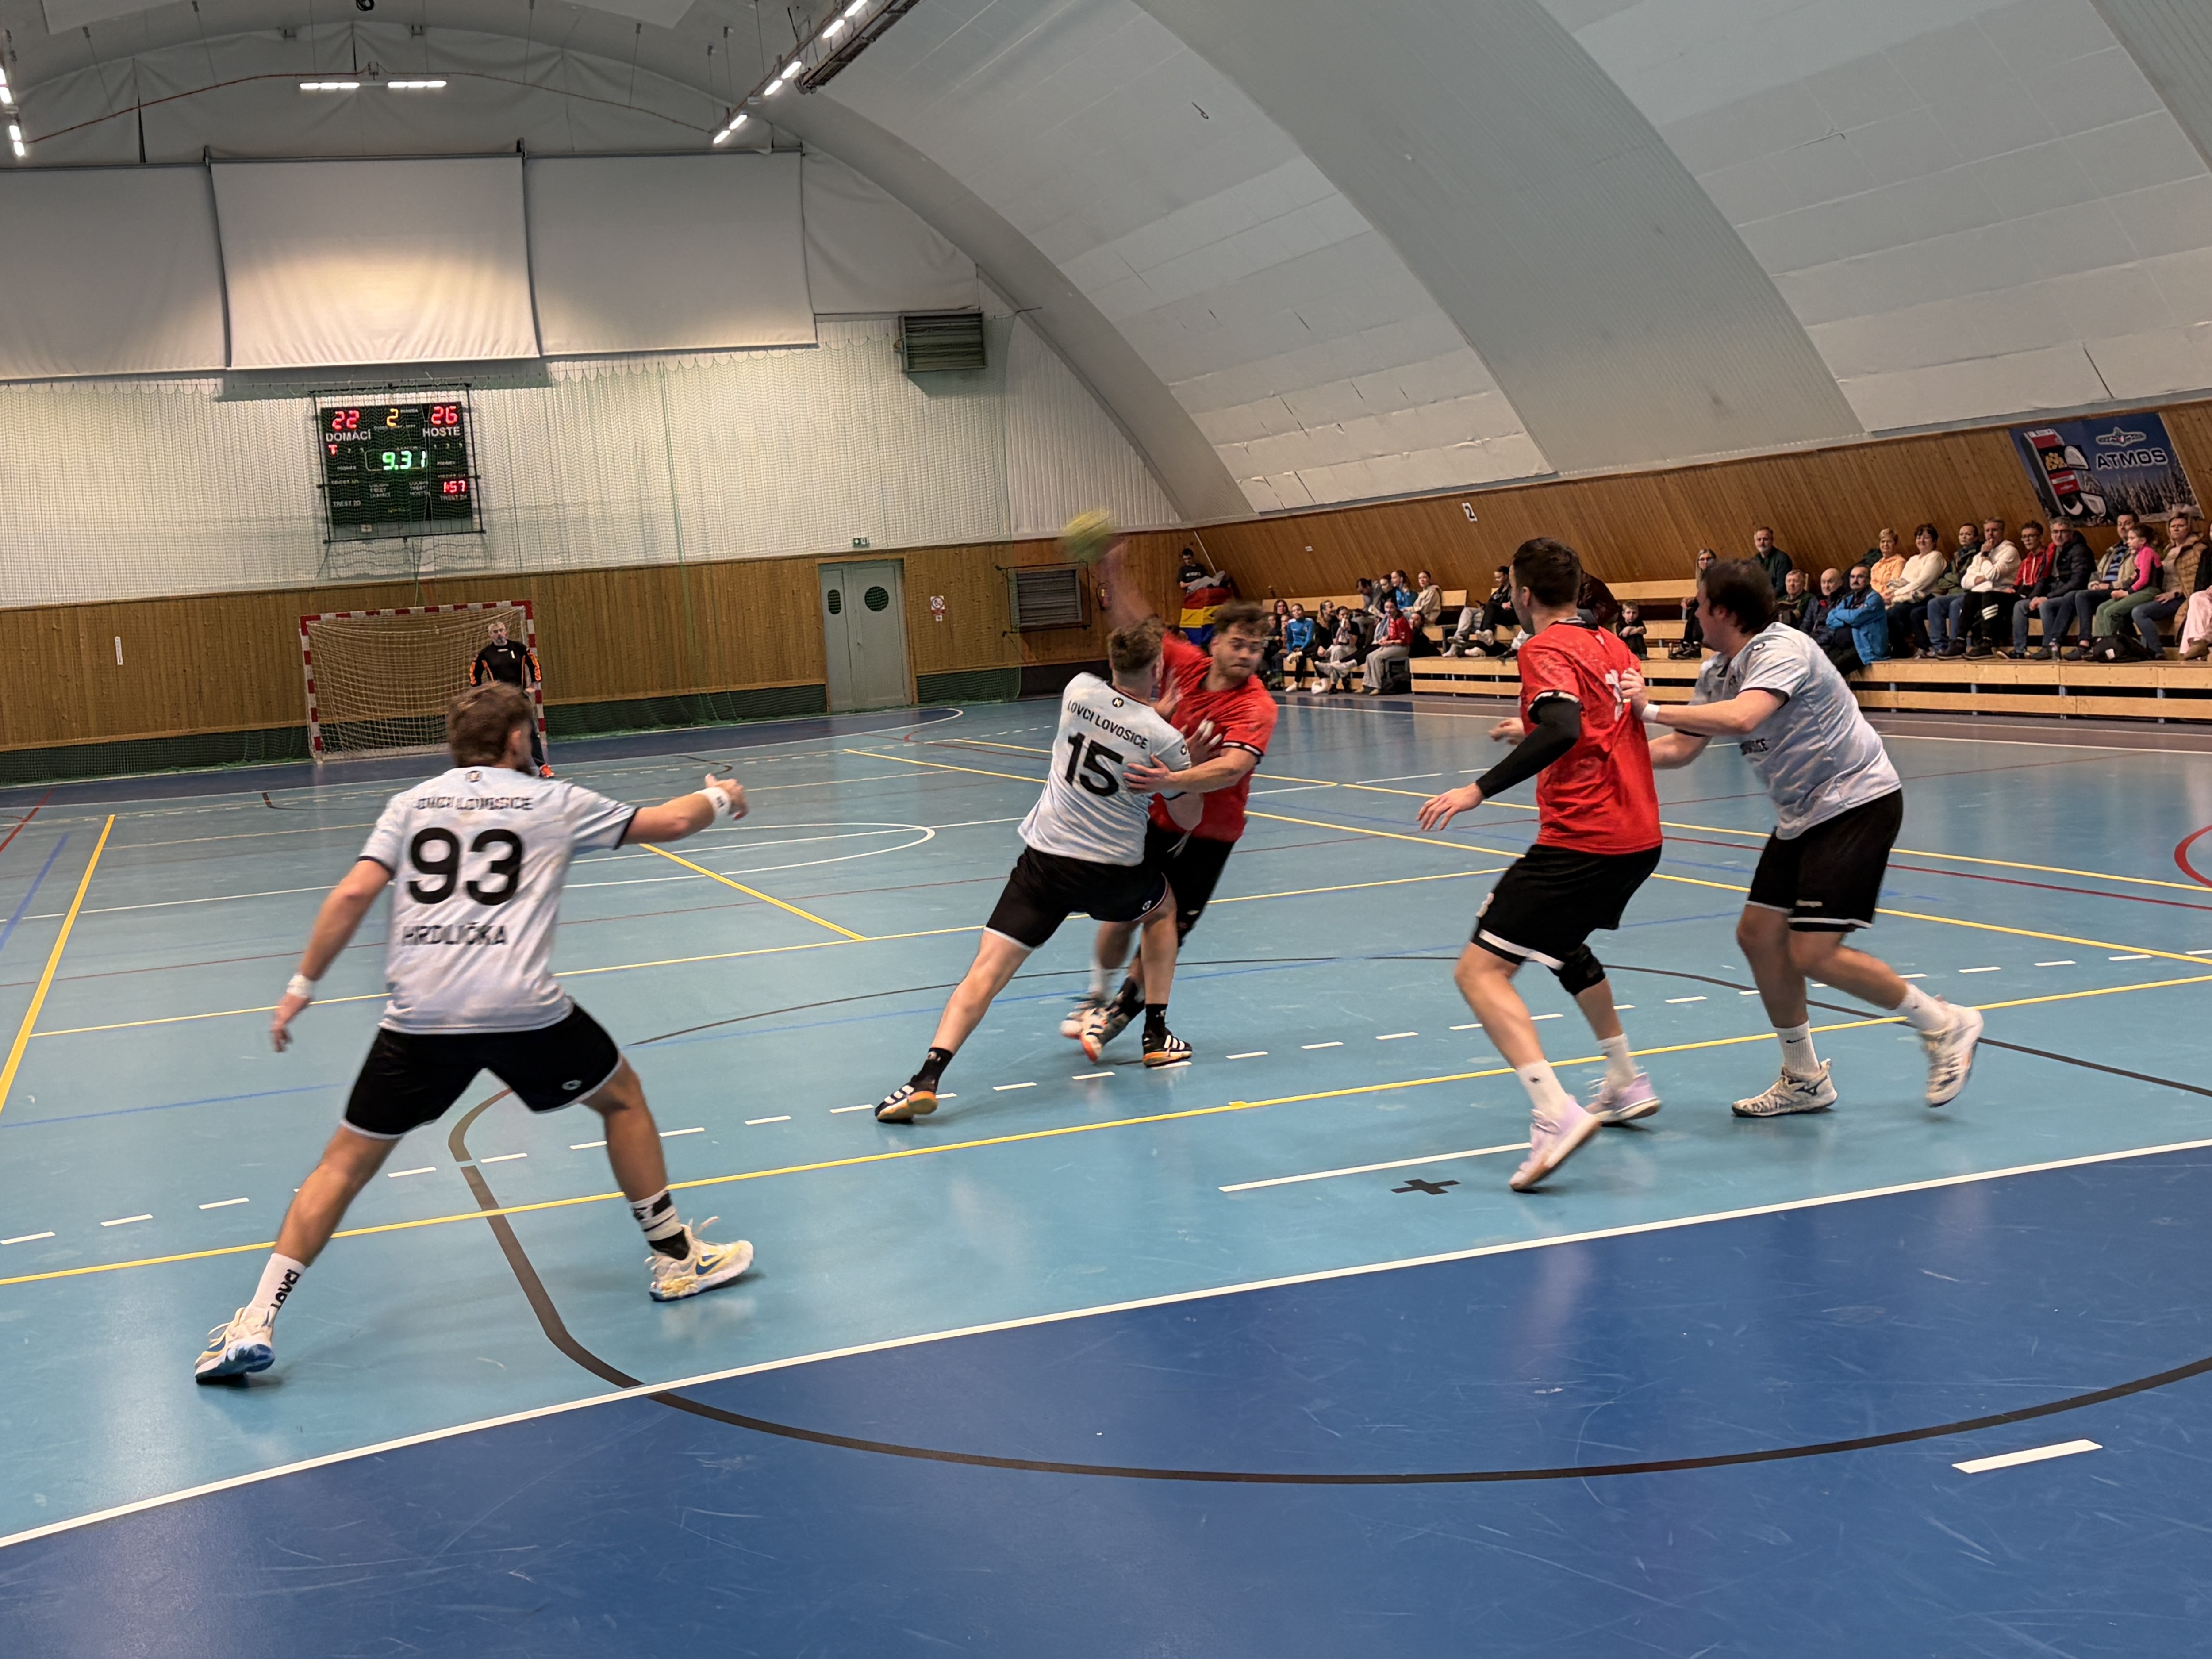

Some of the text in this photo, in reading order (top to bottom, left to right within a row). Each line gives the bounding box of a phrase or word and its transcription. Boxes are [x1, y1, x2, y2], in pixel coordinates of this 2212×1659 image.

[332, 410, 360, 430] 22
[386, 408, 399, 427] 2
[431, 406, 458, 424] 26
[2097, 448, 2168, 469] ATMOS
[1464, 505, 1475, 519] 2
[1067, 700, 1149, 749] LOVCI LOVOSICE
[1064, 732, 1124, 797] 15
[407, 827, 522, 906] 93
